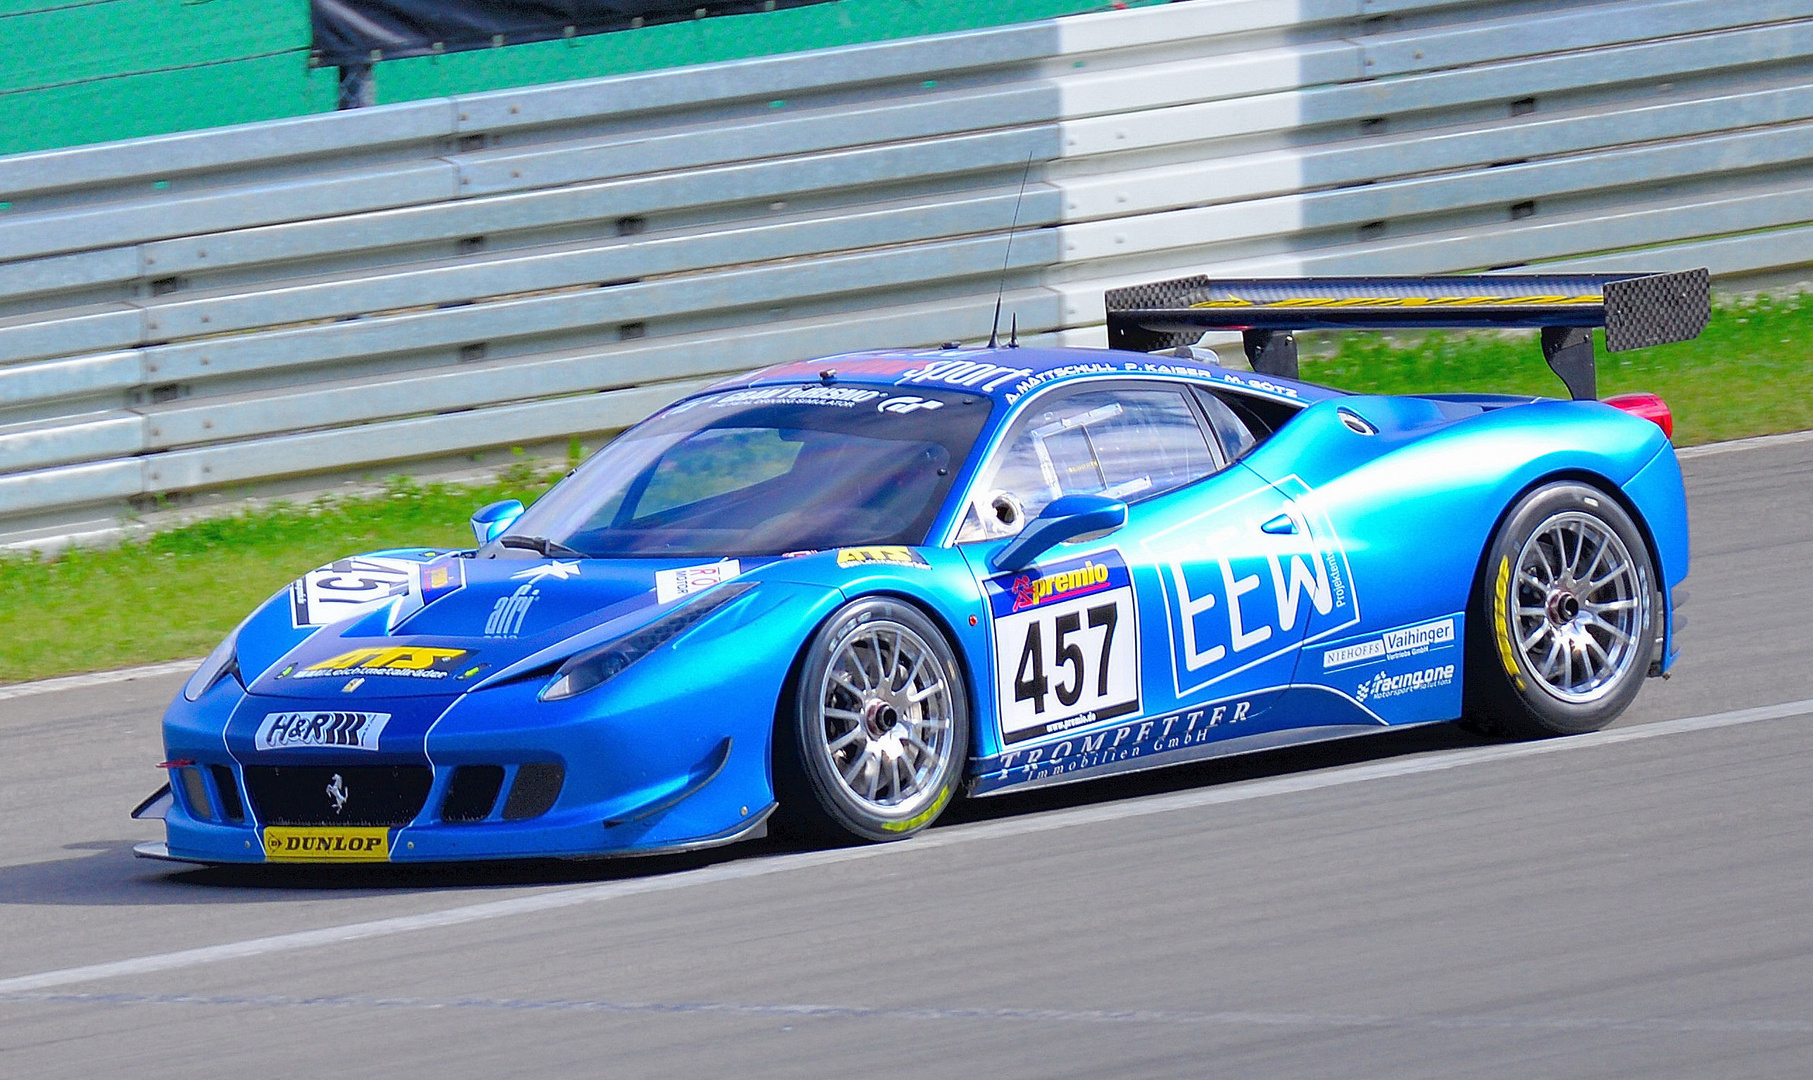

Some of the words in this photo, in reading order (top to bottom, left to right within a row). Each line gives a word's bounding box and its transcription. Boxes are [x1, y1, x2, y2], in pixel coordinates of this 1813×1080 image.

[899, 360, 1033, 392] sport
[836, 546, 912, 564] ATS
[1032, 560, 1109, 605] premio
[1169, 496, 1334, 672] EEW
[484, 583, 540, 635] afri
[304, 645, 468, 671] ATS
[1014, 601, 1118, 715] 457
[1327, 643, 1381, 664] NIEHOFFS
[1386, 626, 1451, 651] Vaihinger
[266, 713, 331, 746] H&R
[997, 700, 1251, 781] TROMPETTER
[1026, 745, 1141, 782] Immobilien
[1153, 728, 1209, 752] GmbH
[285, 836, 382, 852] DUNLOP
